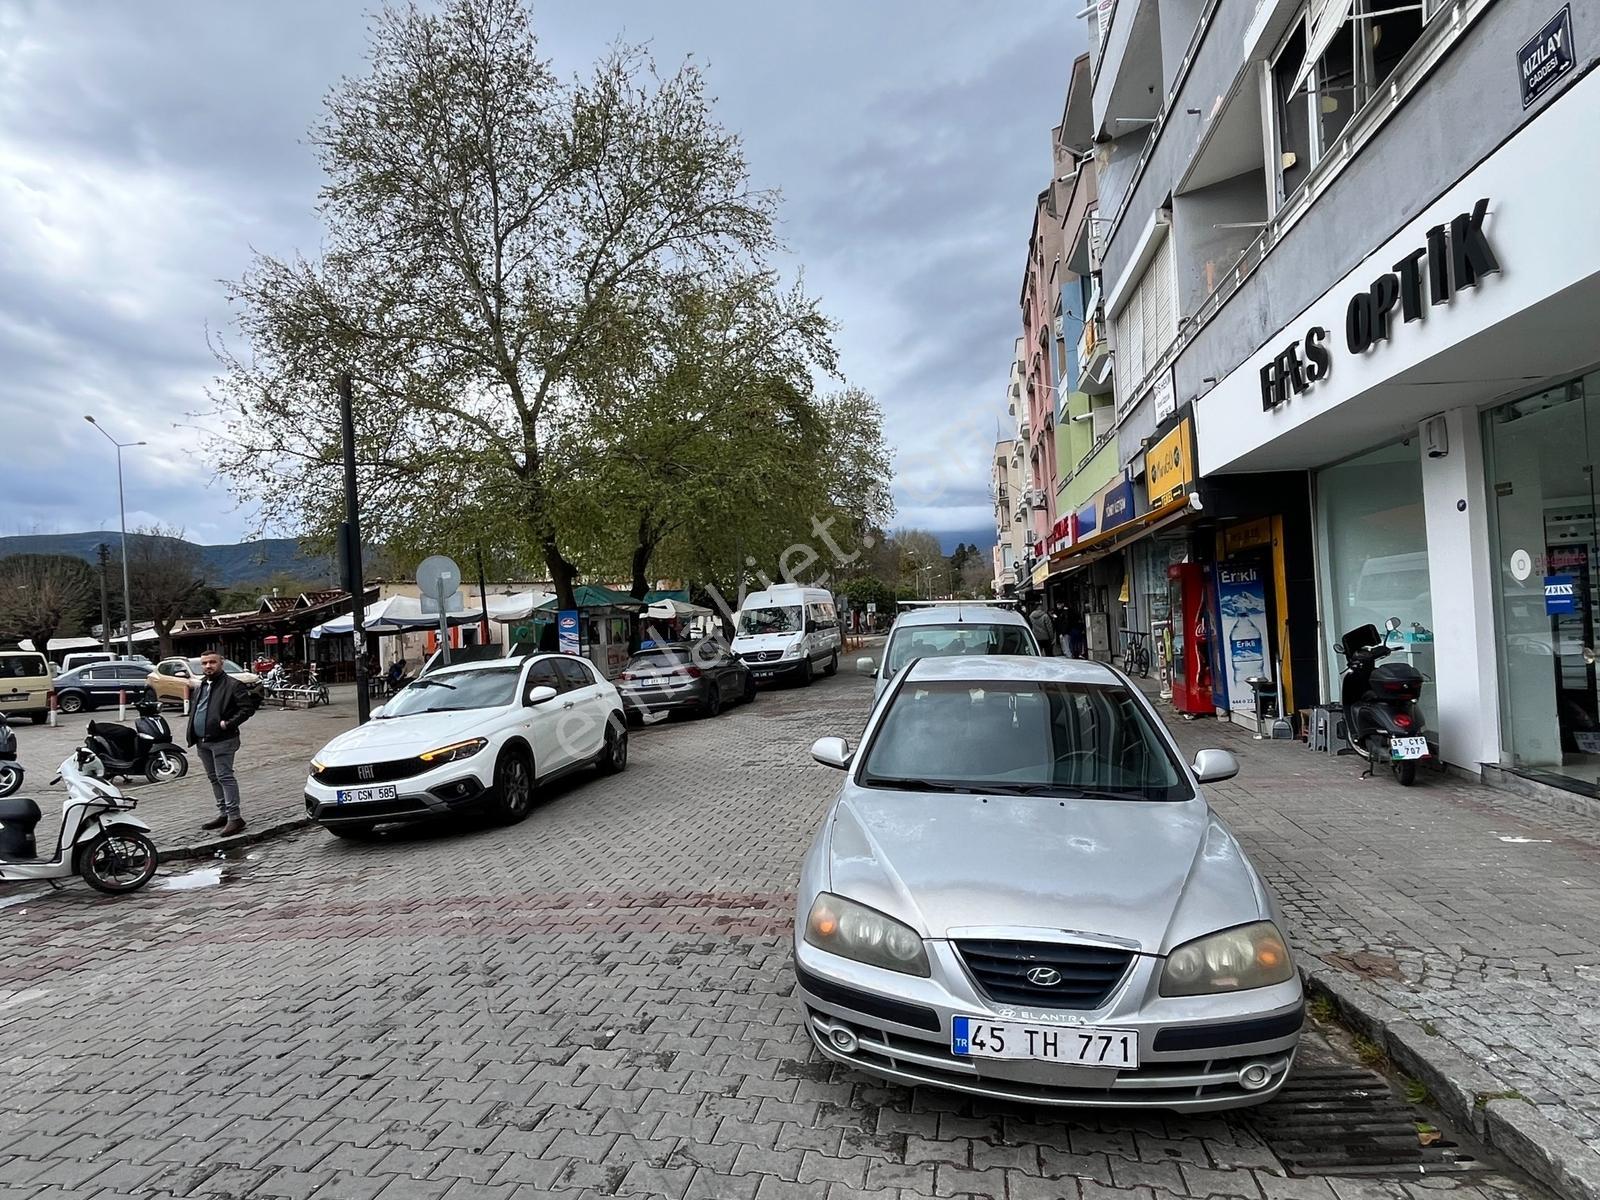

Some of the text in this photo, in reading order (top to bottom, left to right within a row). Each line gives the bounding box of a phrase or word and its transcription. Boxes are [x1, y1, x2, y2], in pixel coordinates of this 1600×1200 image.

[1522, 28, 1562, 79] KIZILAY
[1260, 326, 1332, 413] EFES
[1544, 584, 1574, 596] ZEISS
[1392, 739, 1403, 747] 35
[357, 764, 375, 780] FIAT
[342, 791, 353, 802] 35
[378, 787, 395, 799] 585
[1021, 1011, 1089, 1024] ELANTRA
[956, 1025, 1129, 1063] TR 45 TH 771
